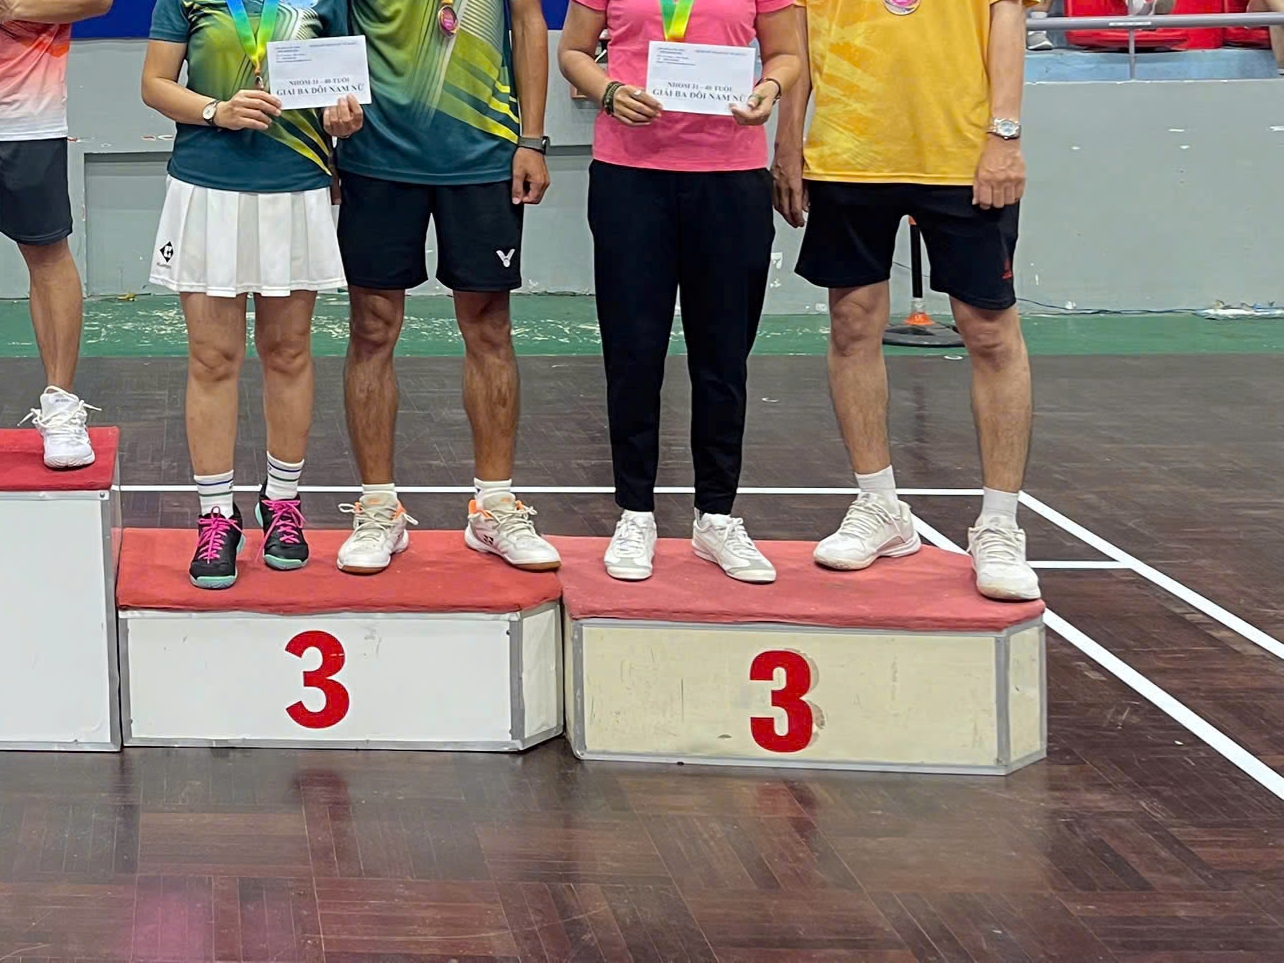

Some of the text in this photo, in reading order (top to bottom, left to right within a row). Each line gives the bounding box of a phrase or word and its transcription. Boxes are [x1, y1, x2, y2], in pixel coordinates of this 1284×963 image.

[329, 85, 350, 93] NAM
[709, 93, 730, 102] NAM
[288, 631, 348, 728] 3
[750, 651, 812, 752] 3
